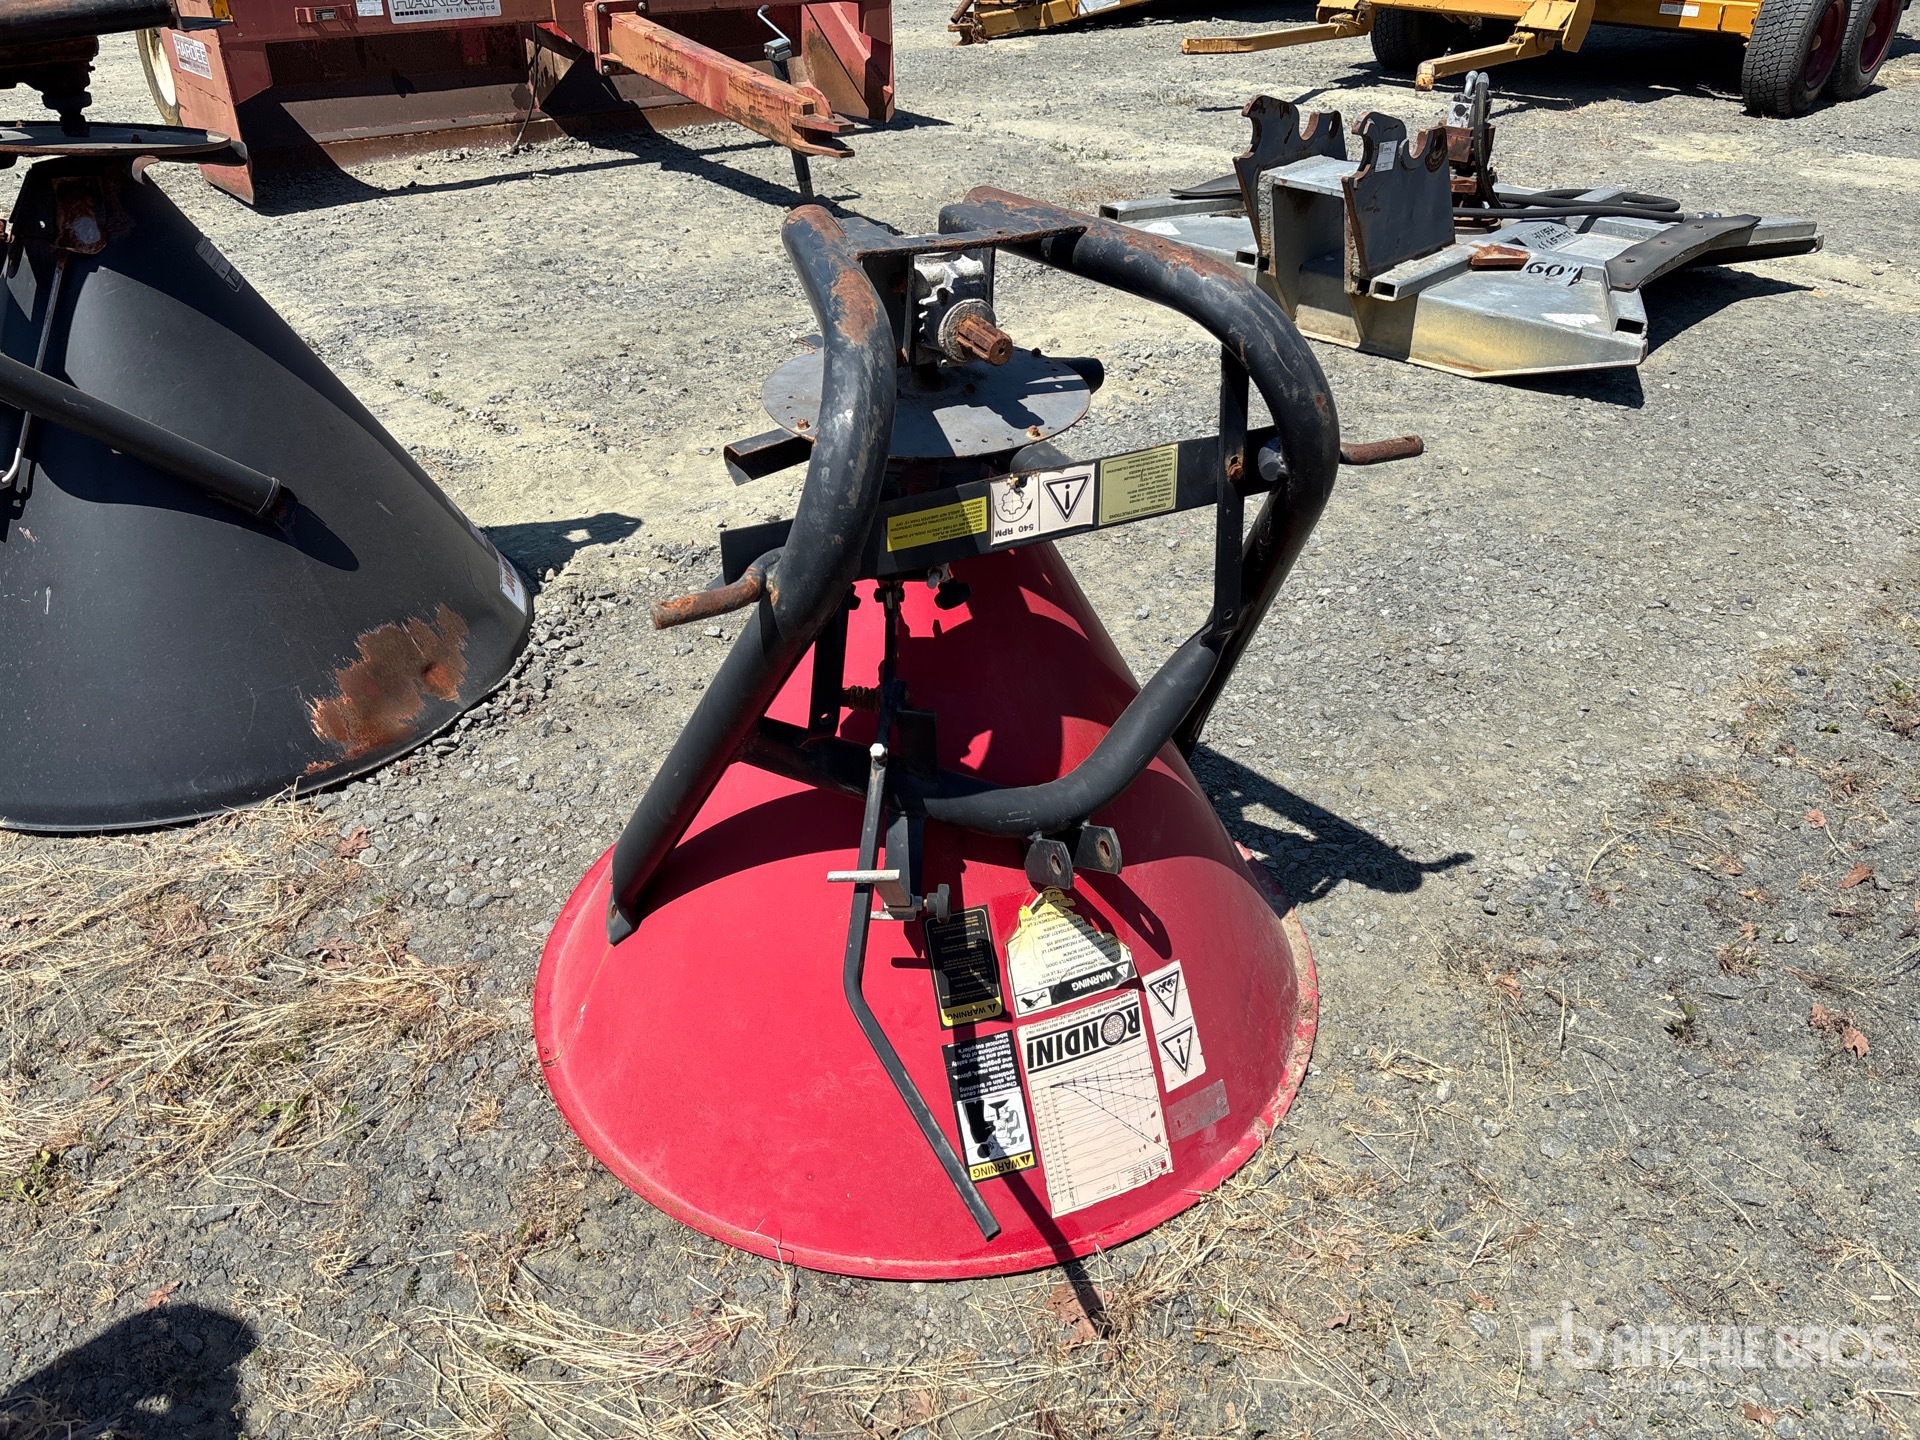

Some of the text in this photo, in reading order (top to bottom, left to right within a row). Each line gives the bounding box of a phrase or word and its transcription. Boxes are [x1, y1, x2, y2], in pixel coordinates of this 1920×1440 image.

[175, 37, 208, 65] HARDEE
[995, 523, 1033, 537] 540 RPM
[1070, 969, 1112, 991] WARNING
[946, 1006, 986, 1020] WARNING
[984, 1037, 1008, 1047] chemical
[1026, 1004, 1141, 1069] RONDINI
[968, 1054, 985, 1063] follow
[997, 1049, 1011, 1057] Read
[950, 1058, 968, 1067] safety
[977, 1057, 1001, 1068] goggles.
[988, 1064, 999, 1072] face
[1000, 1061, 1013, 1070] Wear
[988, 1068, 1015, 1079] problems.
[1004, 1074, 1016, 1082] eye,
[958, 1081, 985, 1092] breathing
[992, 1077, 1003, 1085] skin
[959, 1080, 1017, 1098] Chemicals may cause
[971, 1157, 1020, 1178] WARNING
